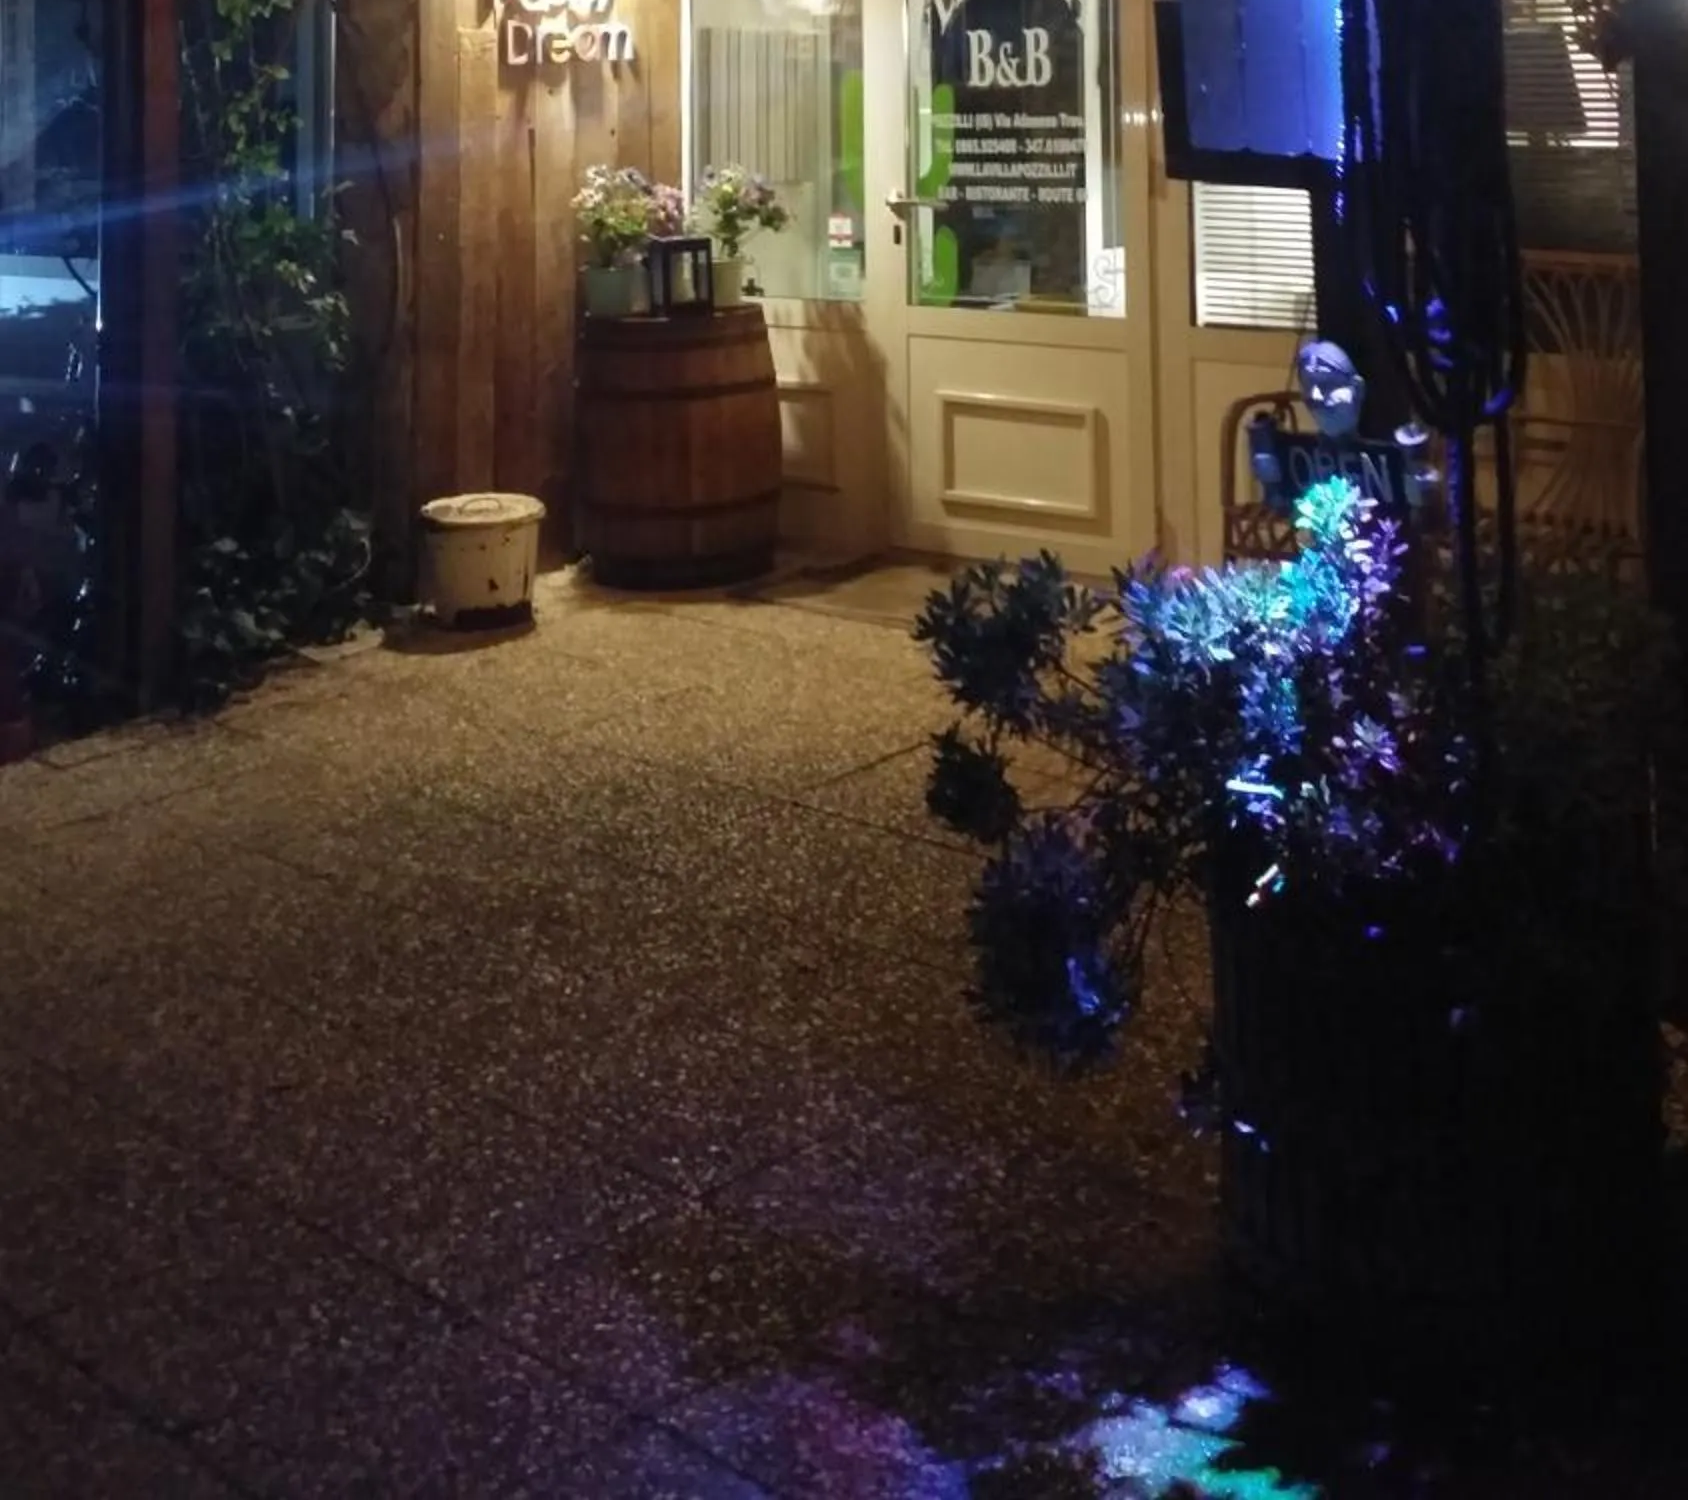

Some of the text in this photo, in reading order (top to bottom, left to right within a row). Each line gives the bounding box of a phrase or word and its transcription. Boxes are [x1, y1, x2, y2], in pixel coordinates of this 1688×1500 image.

[507, 19, 635, 65] Dream
[966, 26, 1052, 88] B&B
[1037, 186, 1074, 203] ROUTE
[1289, 446, 1393, 503] OPEN
